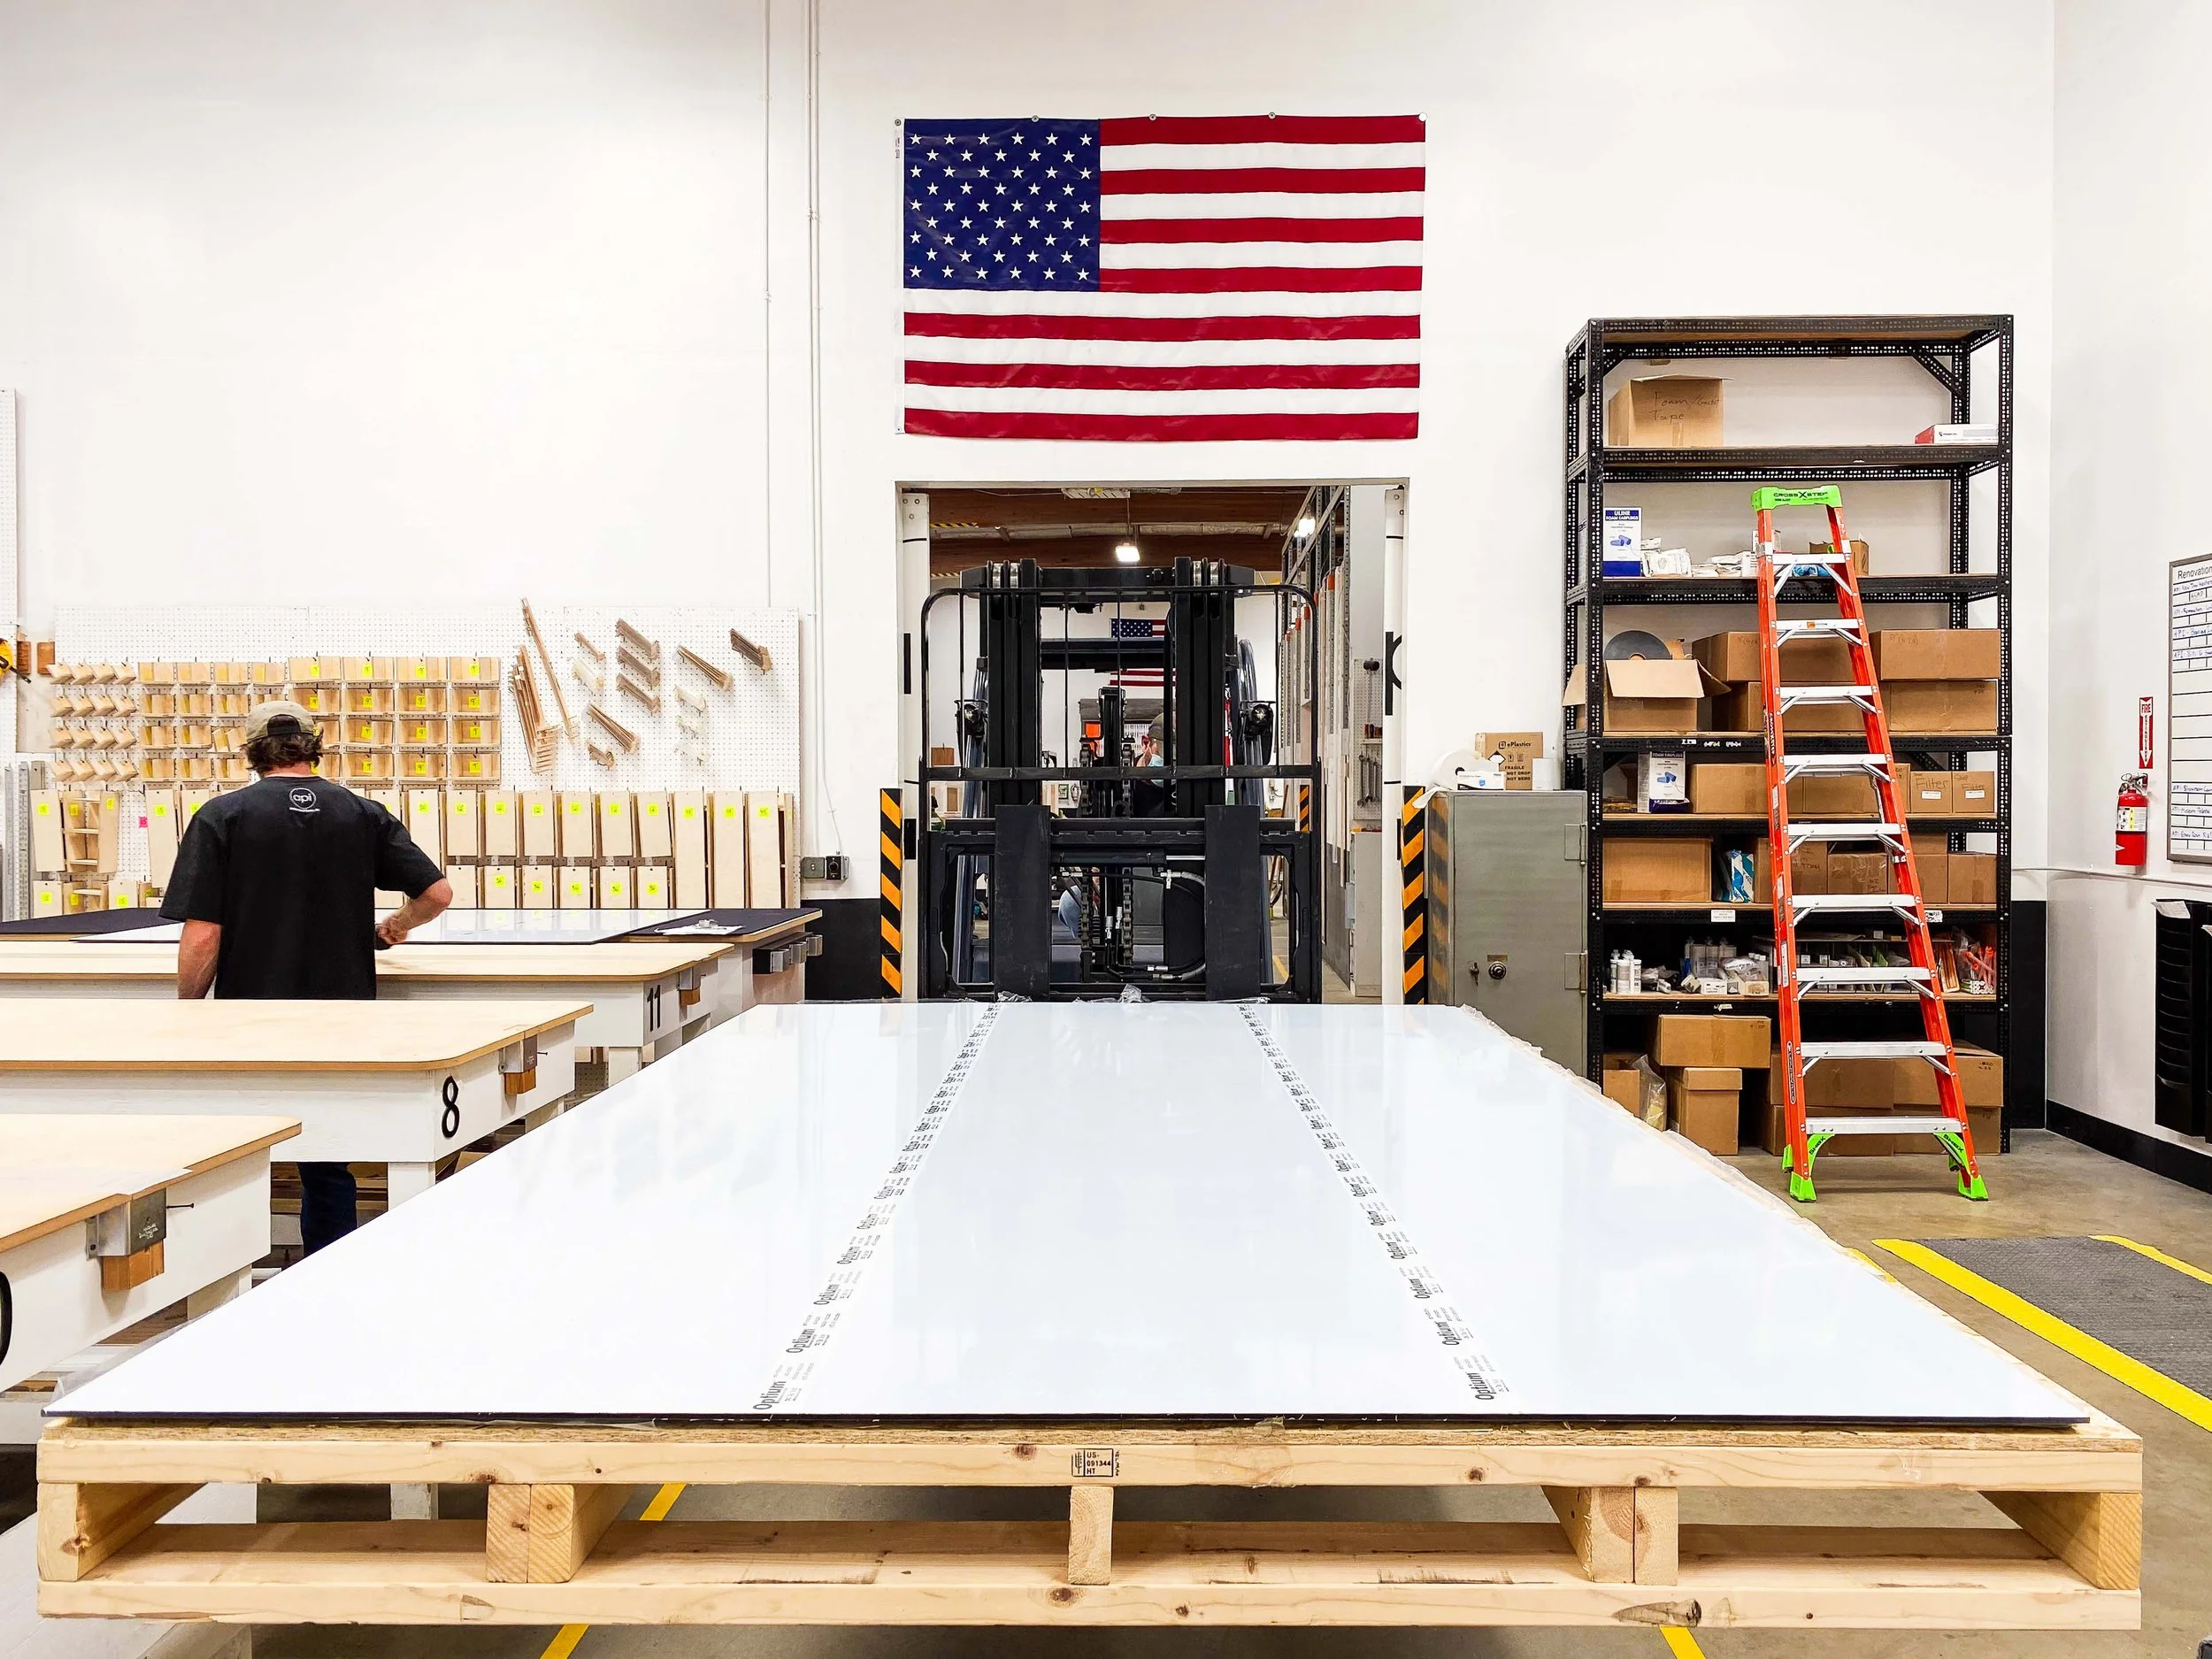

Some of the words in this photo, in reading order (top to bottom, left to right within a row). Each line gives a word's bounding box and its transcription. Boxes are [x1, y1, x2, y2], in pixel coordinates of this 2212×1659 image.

[1649, 410, 1685, 425] Tape
[2142, 703, 2151, 713] FIRE
[1916, 778, 1948, 789] Filter
[293, 793, 312, 803] api
[647, 985, 661, 1032] 11
[442, 1075, 460, 1139] 8
[1809, 1136, 1826, 1155] SHOX
[813, 1284, 840, 1305] Optium
[1409, 1279, 1432, 1298] Optium
[786, 1329, 816, 1353] Optium
[1434, 1321, 1463, 1345] Optium
[753, 1381, 787, 1409] Optium
[1465, 1372, 1497, 1400] Optium
